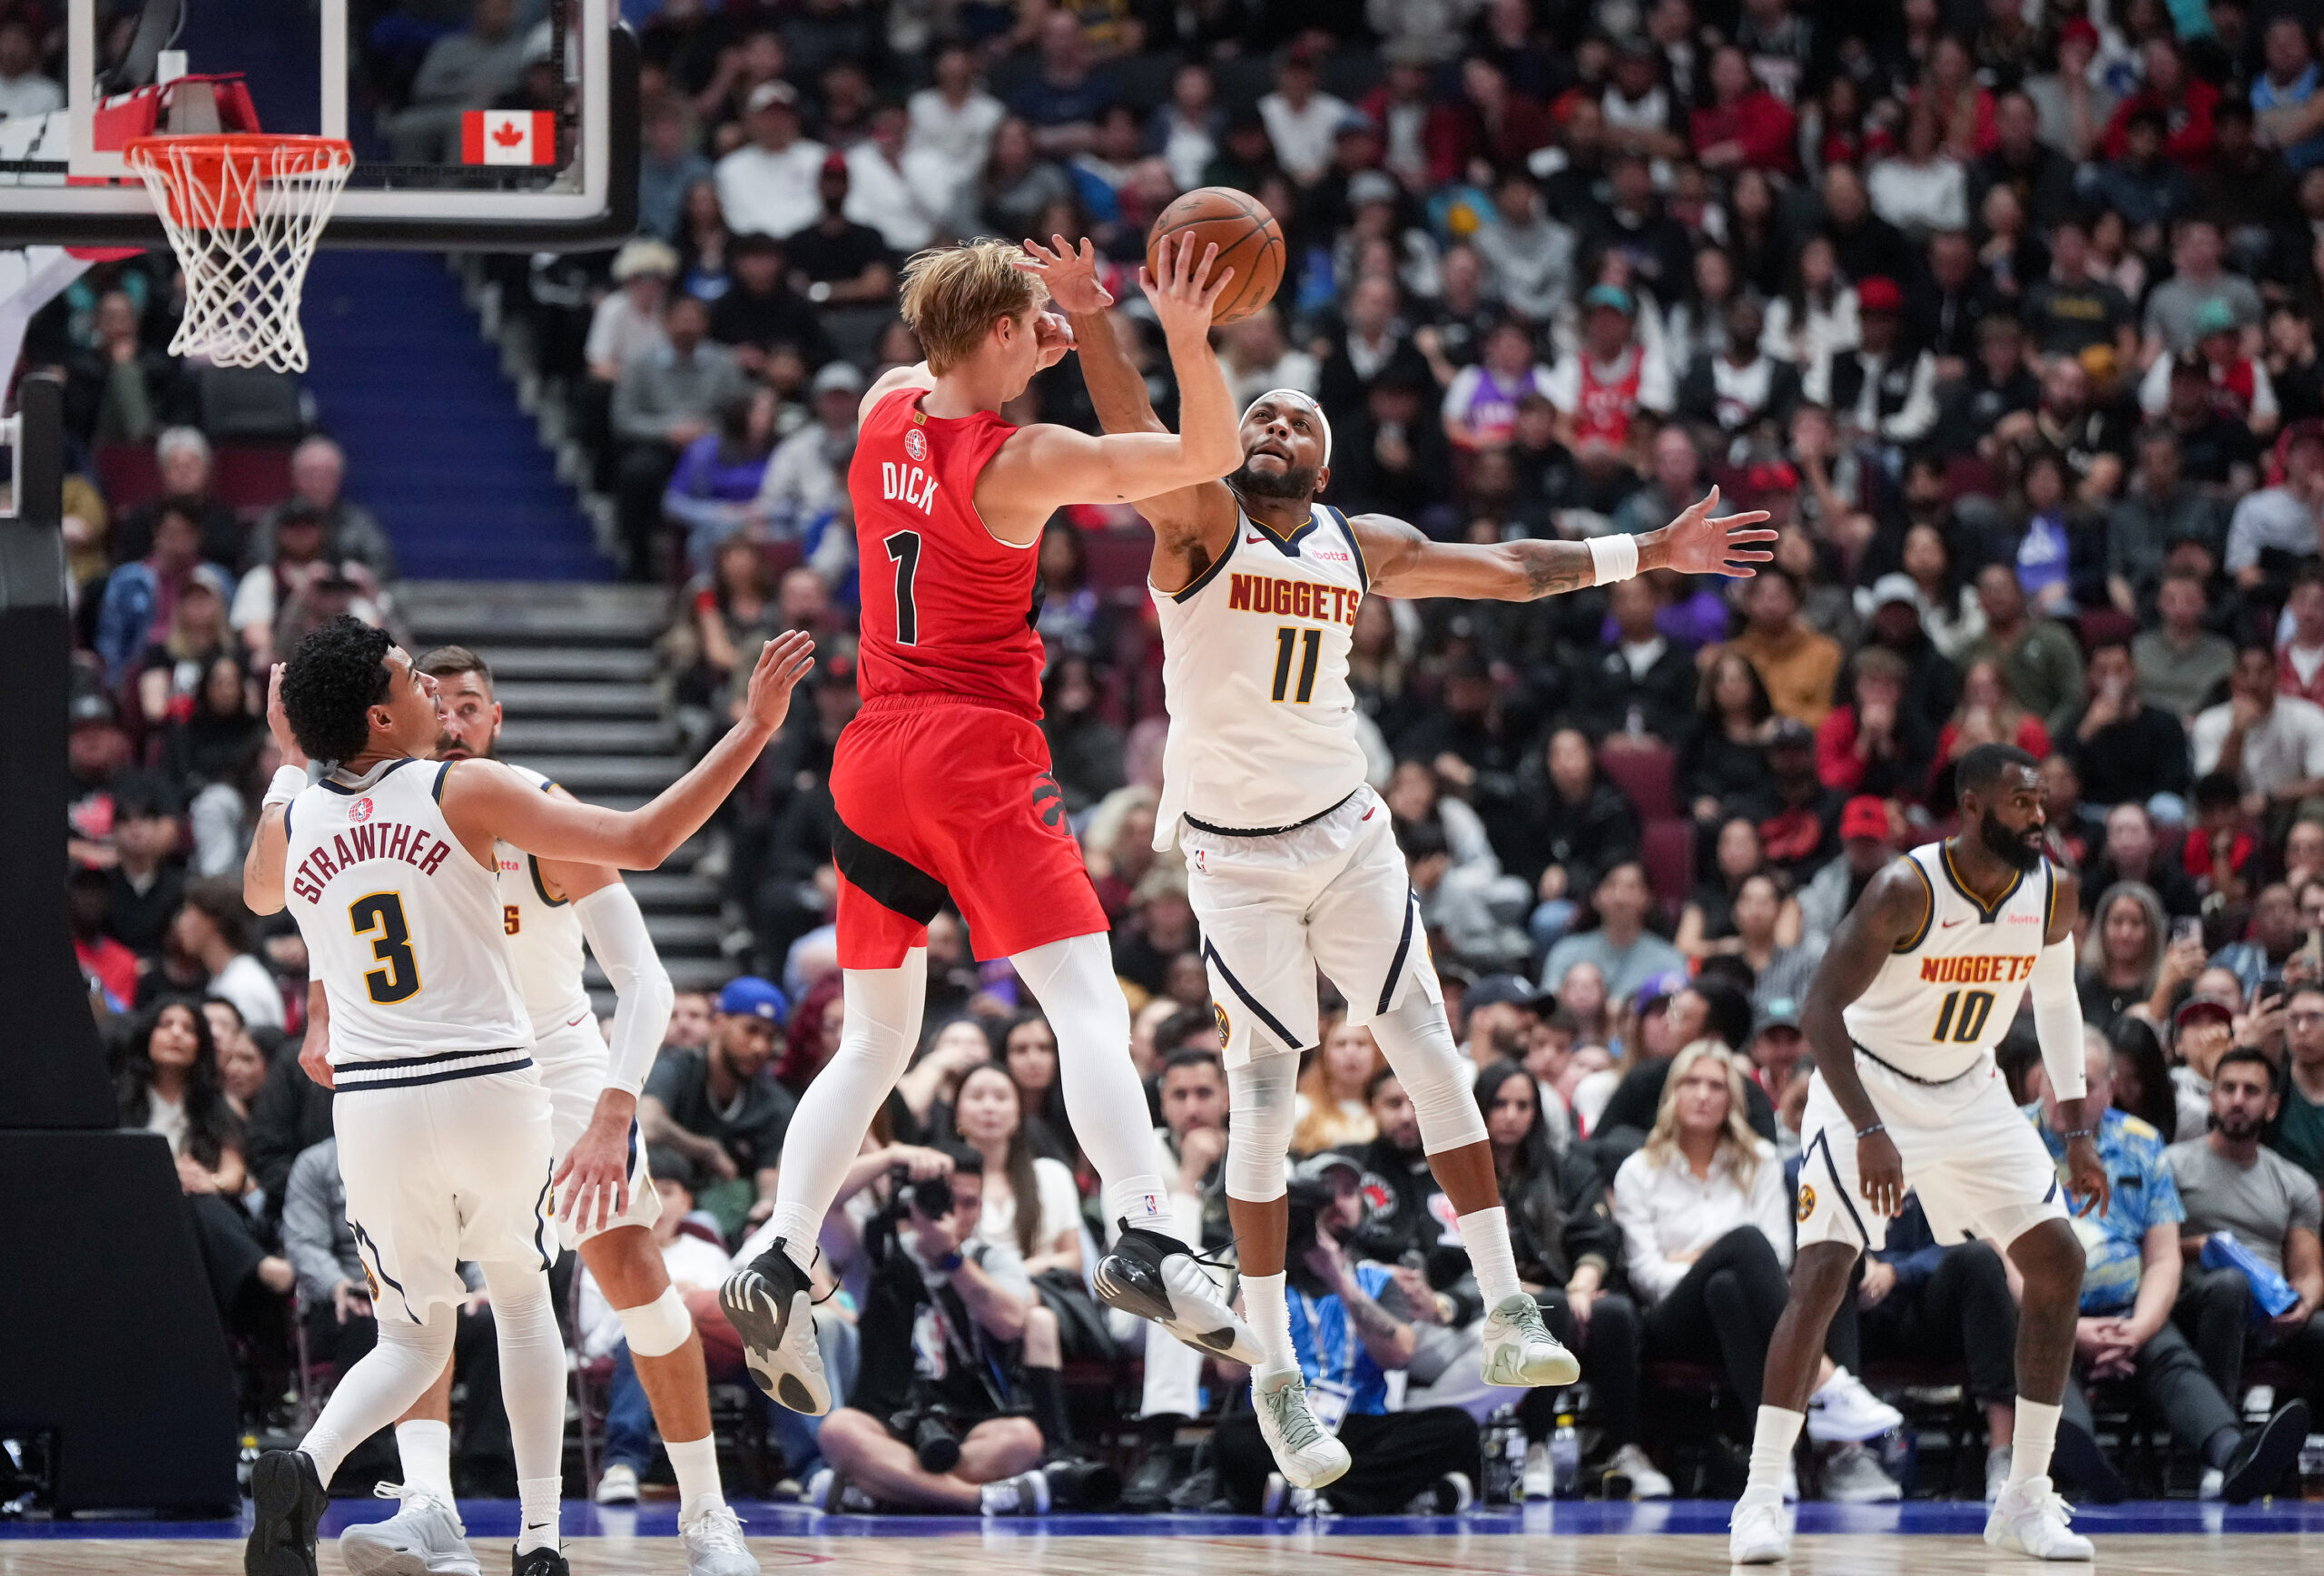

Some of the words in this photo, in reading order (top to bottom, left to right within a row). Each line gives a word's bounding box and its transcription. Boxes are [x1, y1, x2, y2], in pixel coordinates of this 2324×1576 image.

[882, 461, 939, 516] DICK
[883, 529, 921, 646] 1
[1312, 550, 1349, 561] ibotta
[1228, 573, 1359, 626] NUGGETS
[1271, 625, 1323, 704] 11
[293, 822, 451, 905] STRAWTHER
[348, 890, 422, 1005] 3
[1932, 989, 1996, 1043] 10
